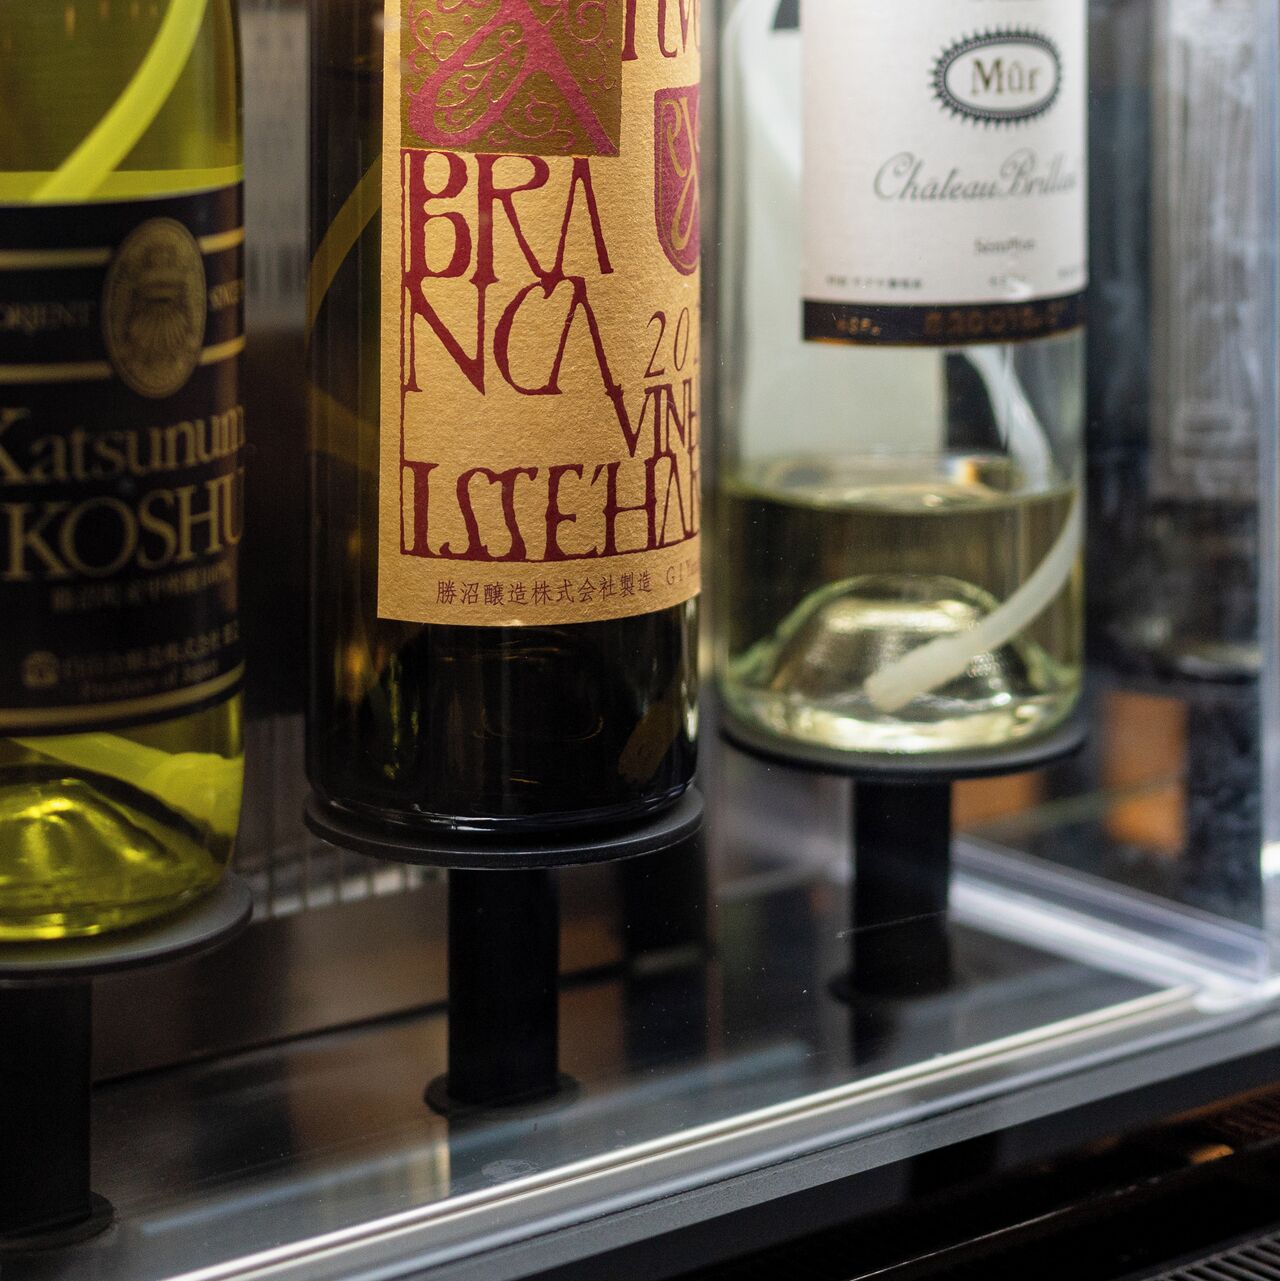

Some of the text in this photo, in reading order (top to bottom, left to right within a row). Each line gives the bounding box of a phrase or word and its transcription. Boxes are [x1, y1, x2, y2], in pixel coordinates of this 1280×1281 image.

[970, 57, 1042, 98] Mûr
[643, 306, 700, 380] 20
[435, 570, 653, 607] 勝沼醸造株式会社製造
